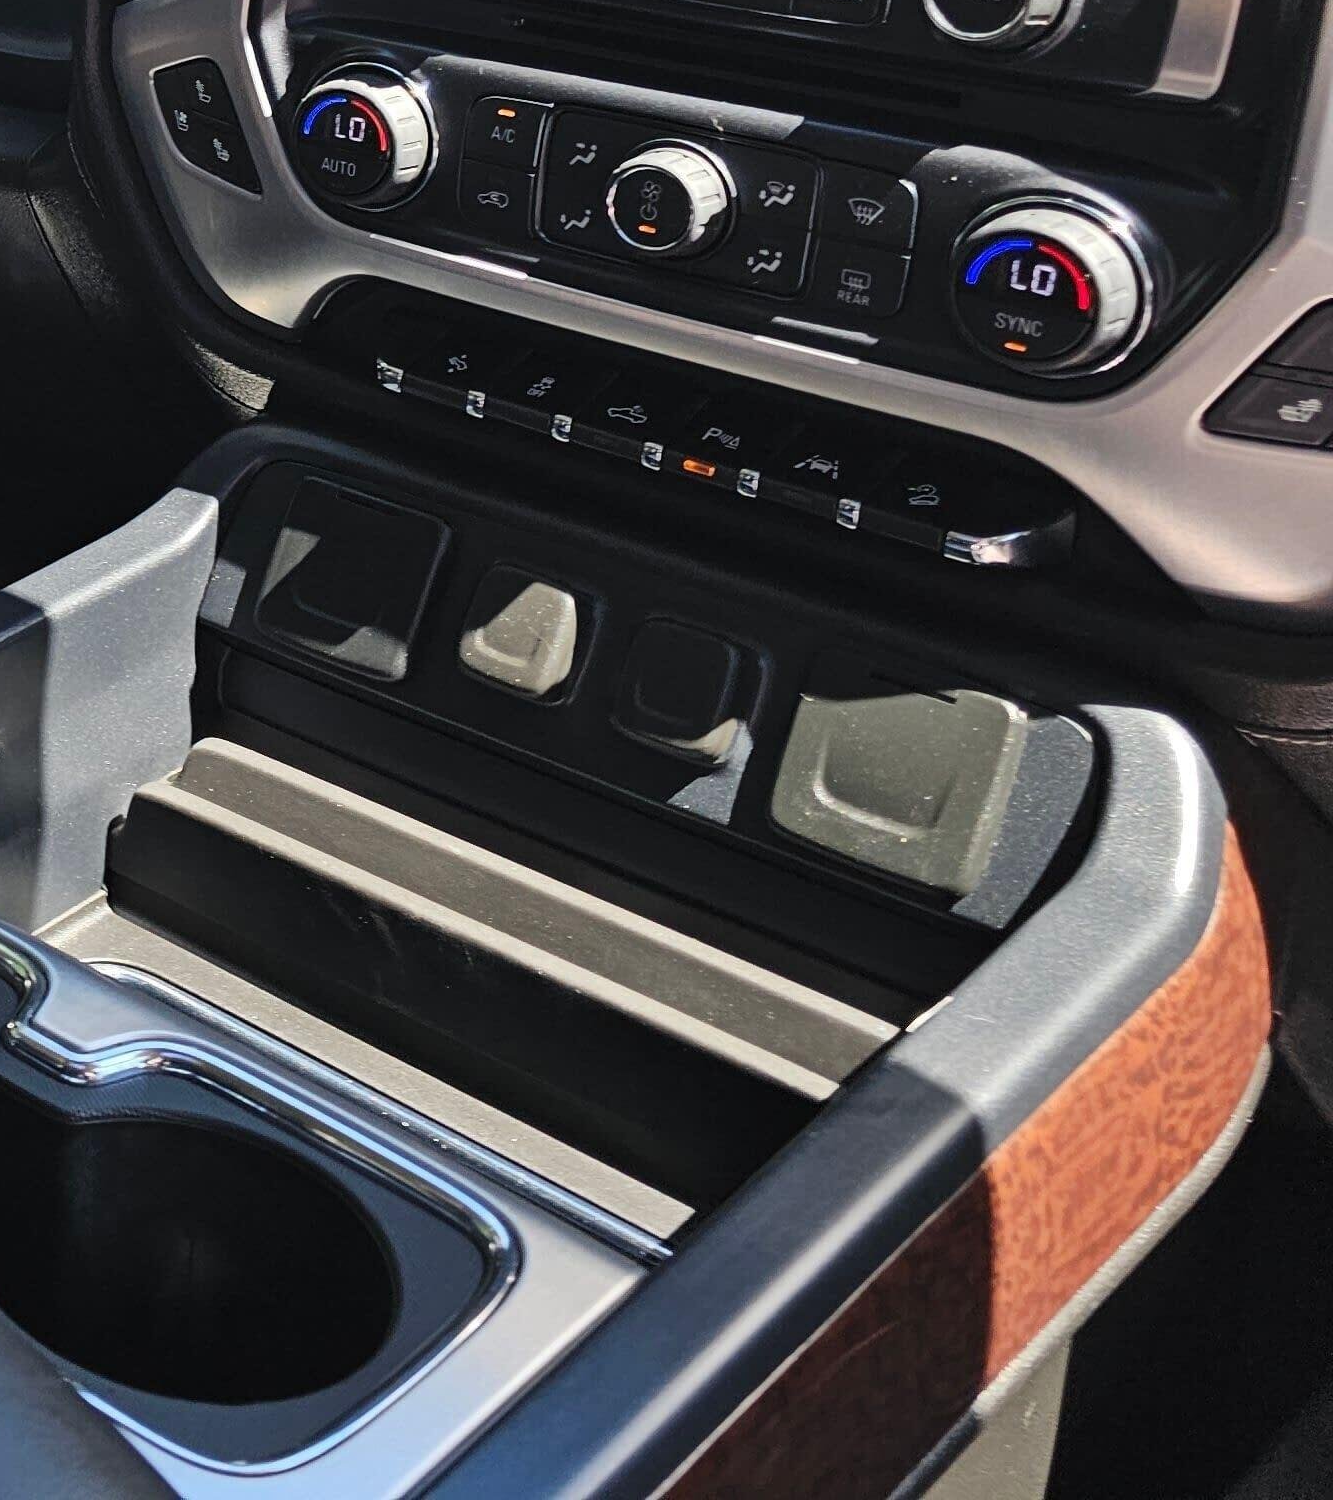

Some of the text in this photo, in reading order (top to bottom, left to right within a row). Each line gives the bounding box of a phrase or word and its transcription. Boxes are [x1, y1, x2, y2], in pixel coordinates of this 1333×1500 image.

[489, 124, 517, 145] A/C
[320, 156, 357, 178] AUTO
[835, 288, 871, 307] REAR
[993, 311, 1044, 338] SYNC
